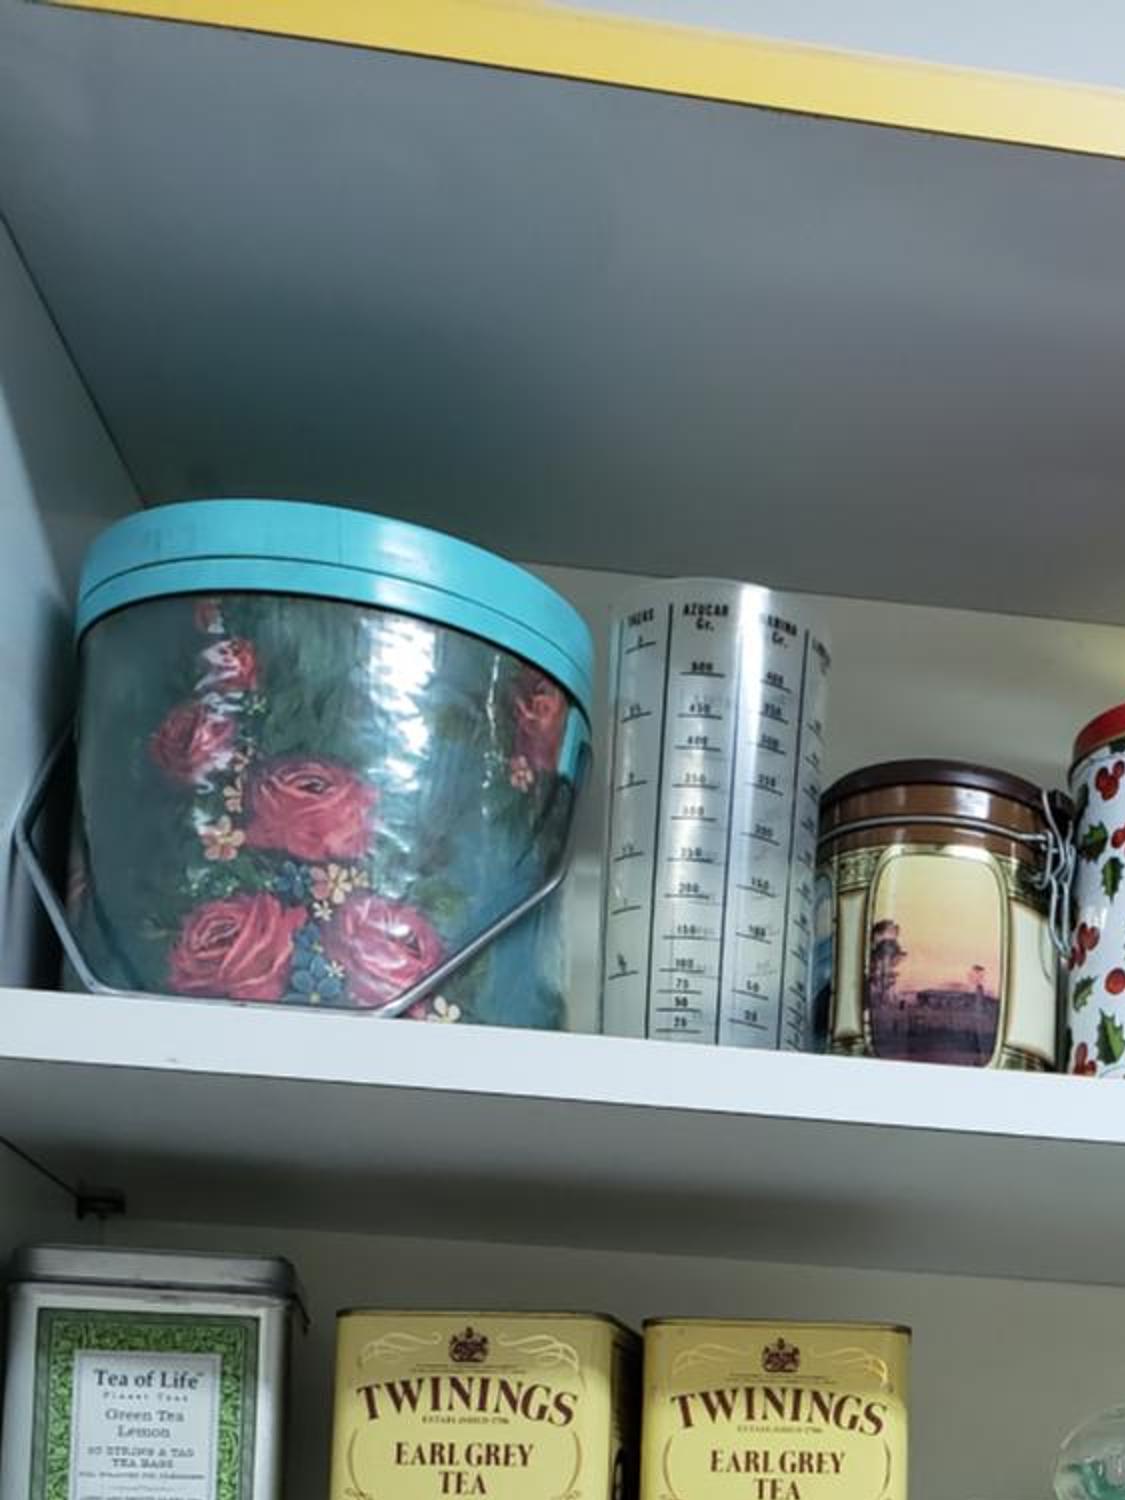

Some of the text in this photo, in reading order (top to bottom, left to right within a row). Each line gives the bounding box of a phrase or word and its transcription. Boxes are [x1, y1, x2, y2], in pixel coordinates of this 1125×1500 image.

[683, 603, 730, 618] AZUCAR
[94, 1368, 199, 1390] Tea of Life
[356, 1375, 578, 1427] TWININGS
[670, 1386, 888, 1437] TWININGS
[104, 1407, 185, 1422] Green Tea
[117, 1424, 171, 1439] Lemon
[395, 1441, 534, 1468] EARL GREY
[709, 1449, 846, 1475] EARL GREY
[438, 1470, 487, 1495] TEA
